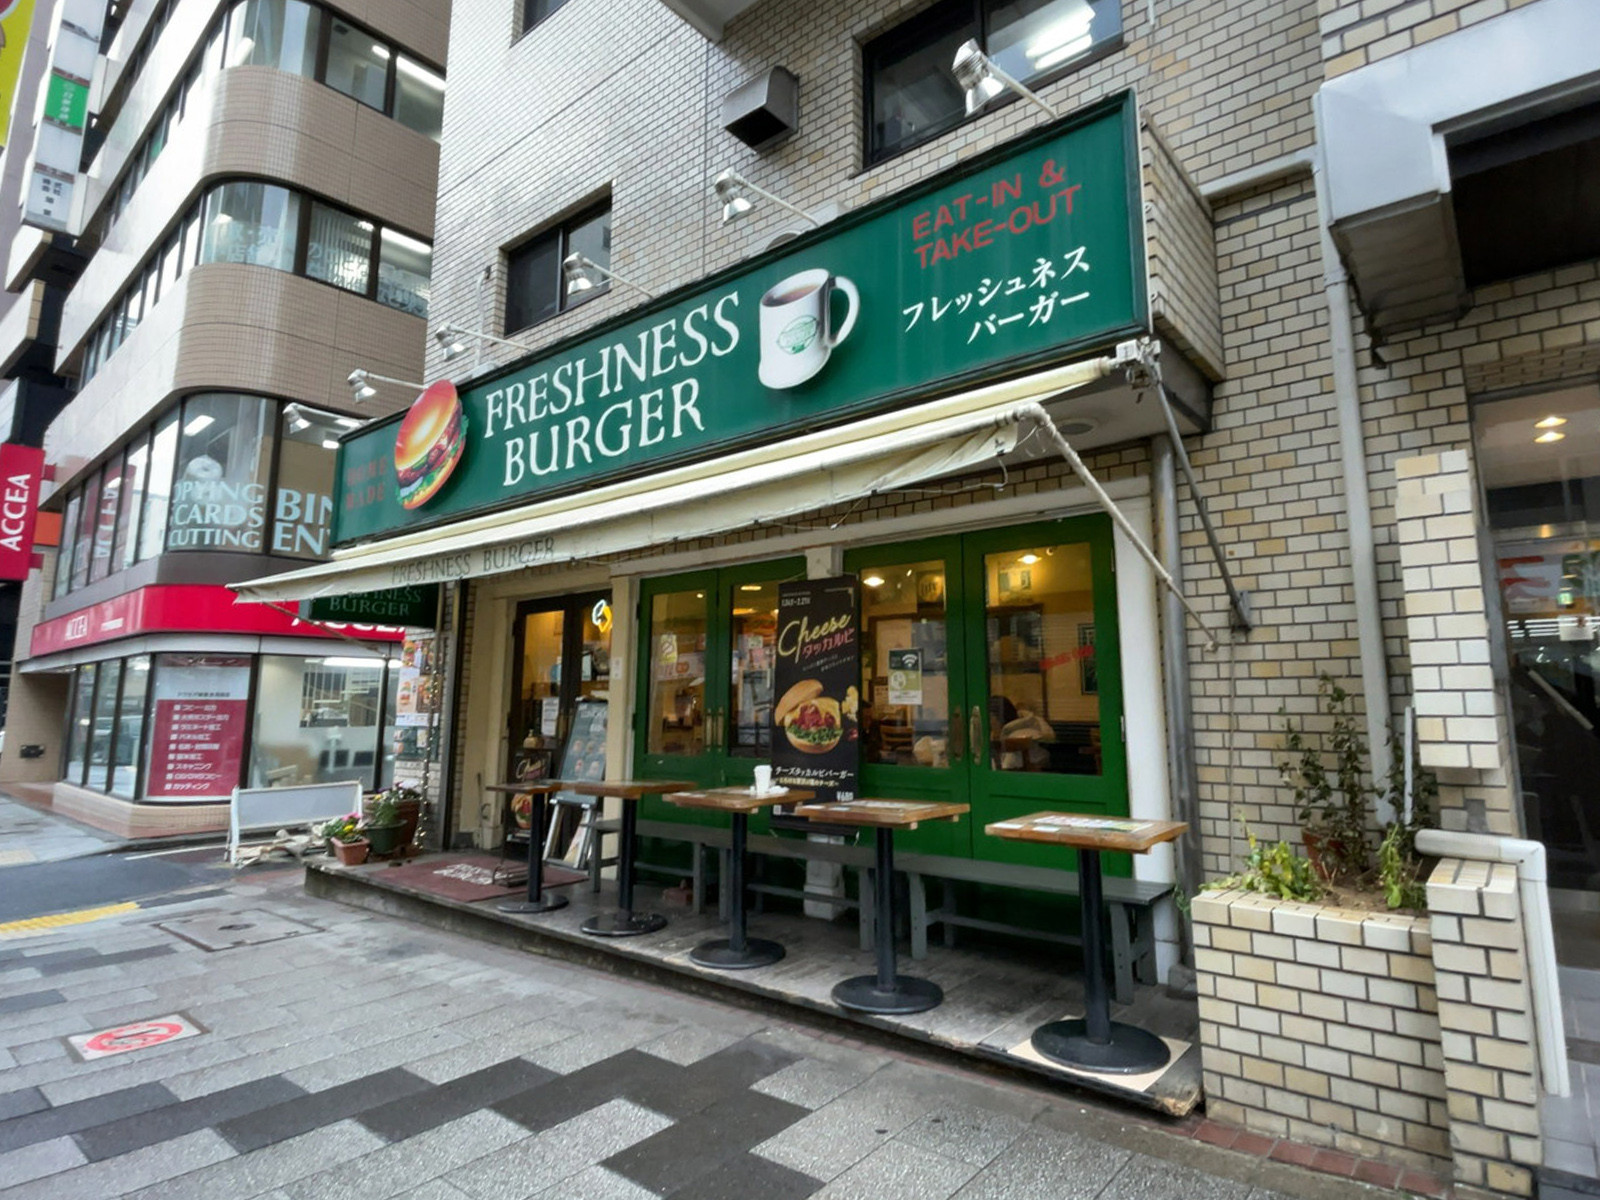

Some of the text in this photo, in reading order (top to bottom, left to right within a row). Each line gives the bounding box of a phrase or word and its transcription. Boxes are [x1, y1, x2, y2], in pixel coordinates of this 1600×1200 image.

[911, 159, 1066, 241] EAT-IN &
[913, 184, 1082, 270] TAKE-OUT
[902, 245, 1092, 333] フレッシュネス
[967, 290, 1092, 345] バーガー
[484, 290, 741, 439] FRESHNESS
[503, 377, 706, 488] BURGER
[0, 473, 31, 551] ACCEA
[169, 528, 261, 549] CUTTING
[174, 503, 265, 528] CARDS
[391, 536, 555, 585] FRESHNESS BURGER
[329, 597, 410, 617] BURGER
[778, 613, 852, 664] Cheese
